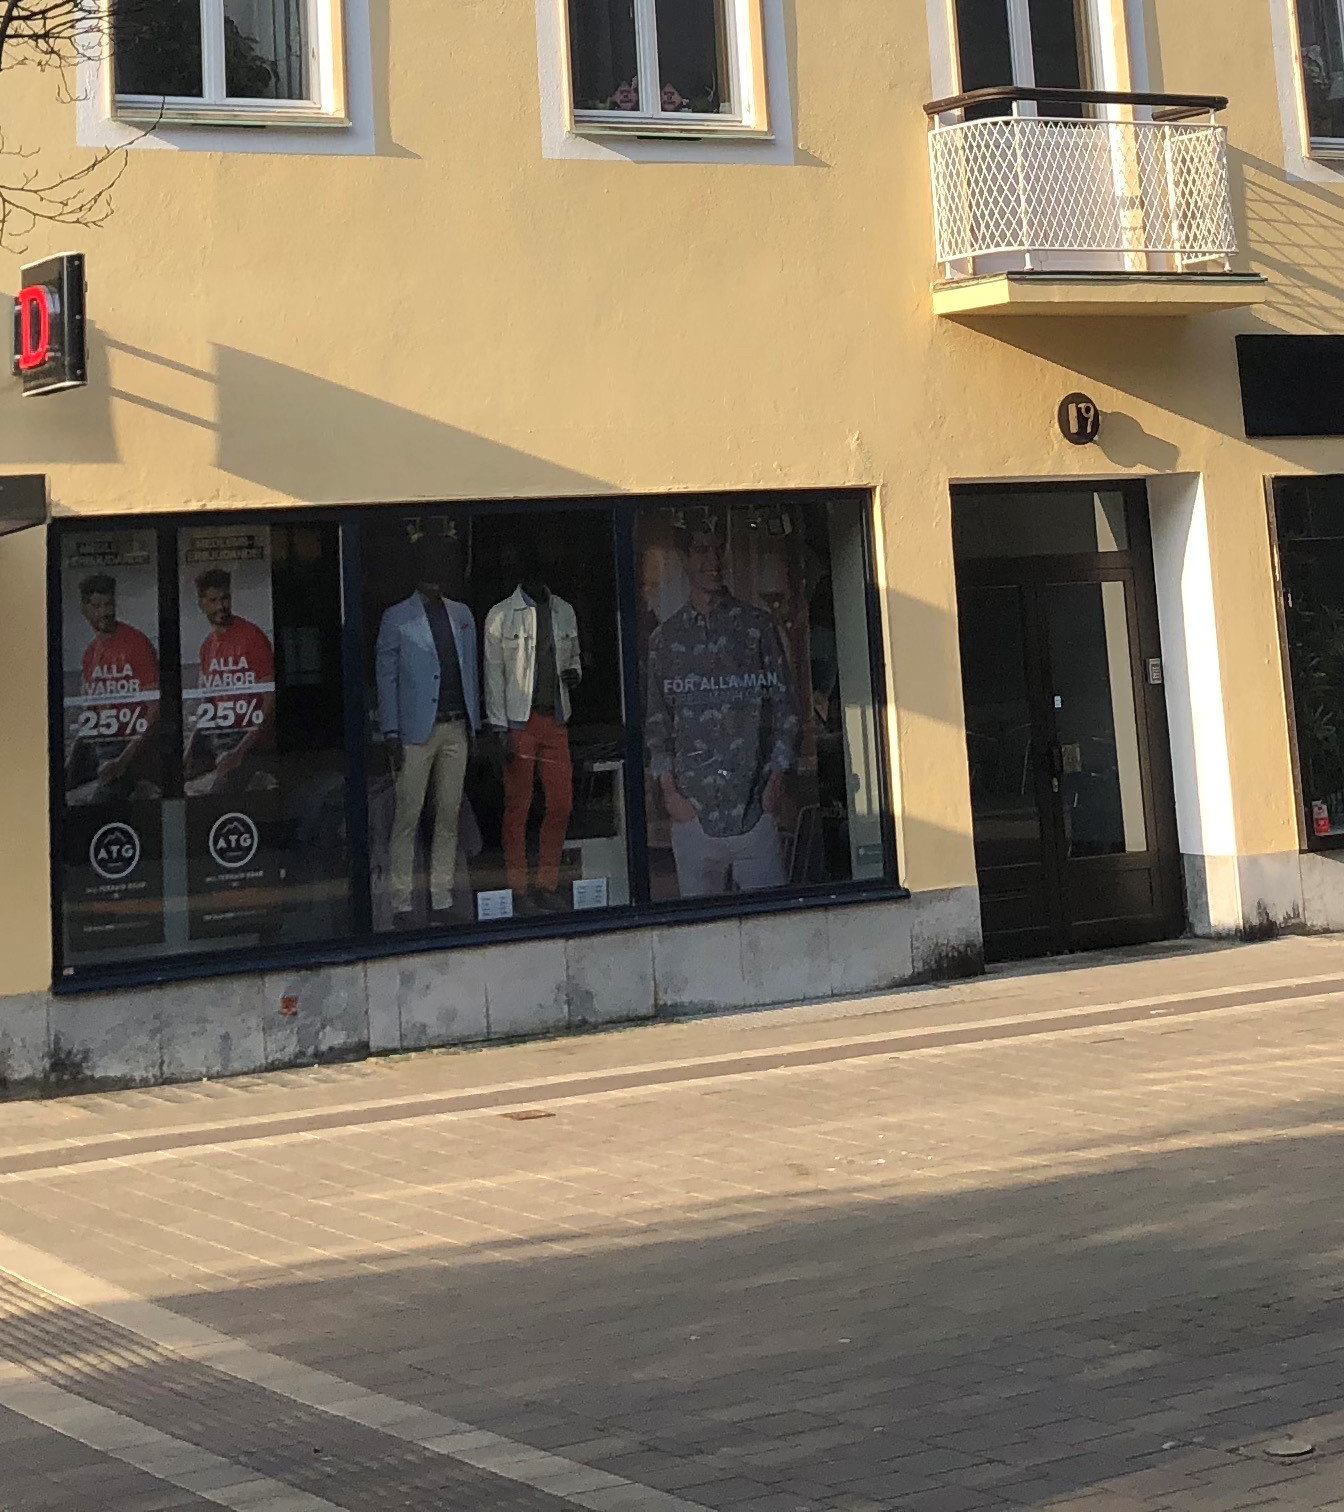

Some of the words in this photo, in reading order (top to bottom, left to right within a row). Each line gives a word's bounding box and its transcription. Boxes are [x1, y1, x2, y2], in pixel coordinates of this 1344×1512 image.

[19, 285, 50, 369] D
[1068, 402, 1095, 434] 19
[91, 663, 133, 679] ALLA
[209, 656, 249, 671] ALLA
[699, 674, 739, 690] ALLA
[69, 706, 148, 737] -25%
[188, 699, 264, 729] -25%
[216, 833, 252, 850] ATG
[97, 844, 134, 860] ATG
